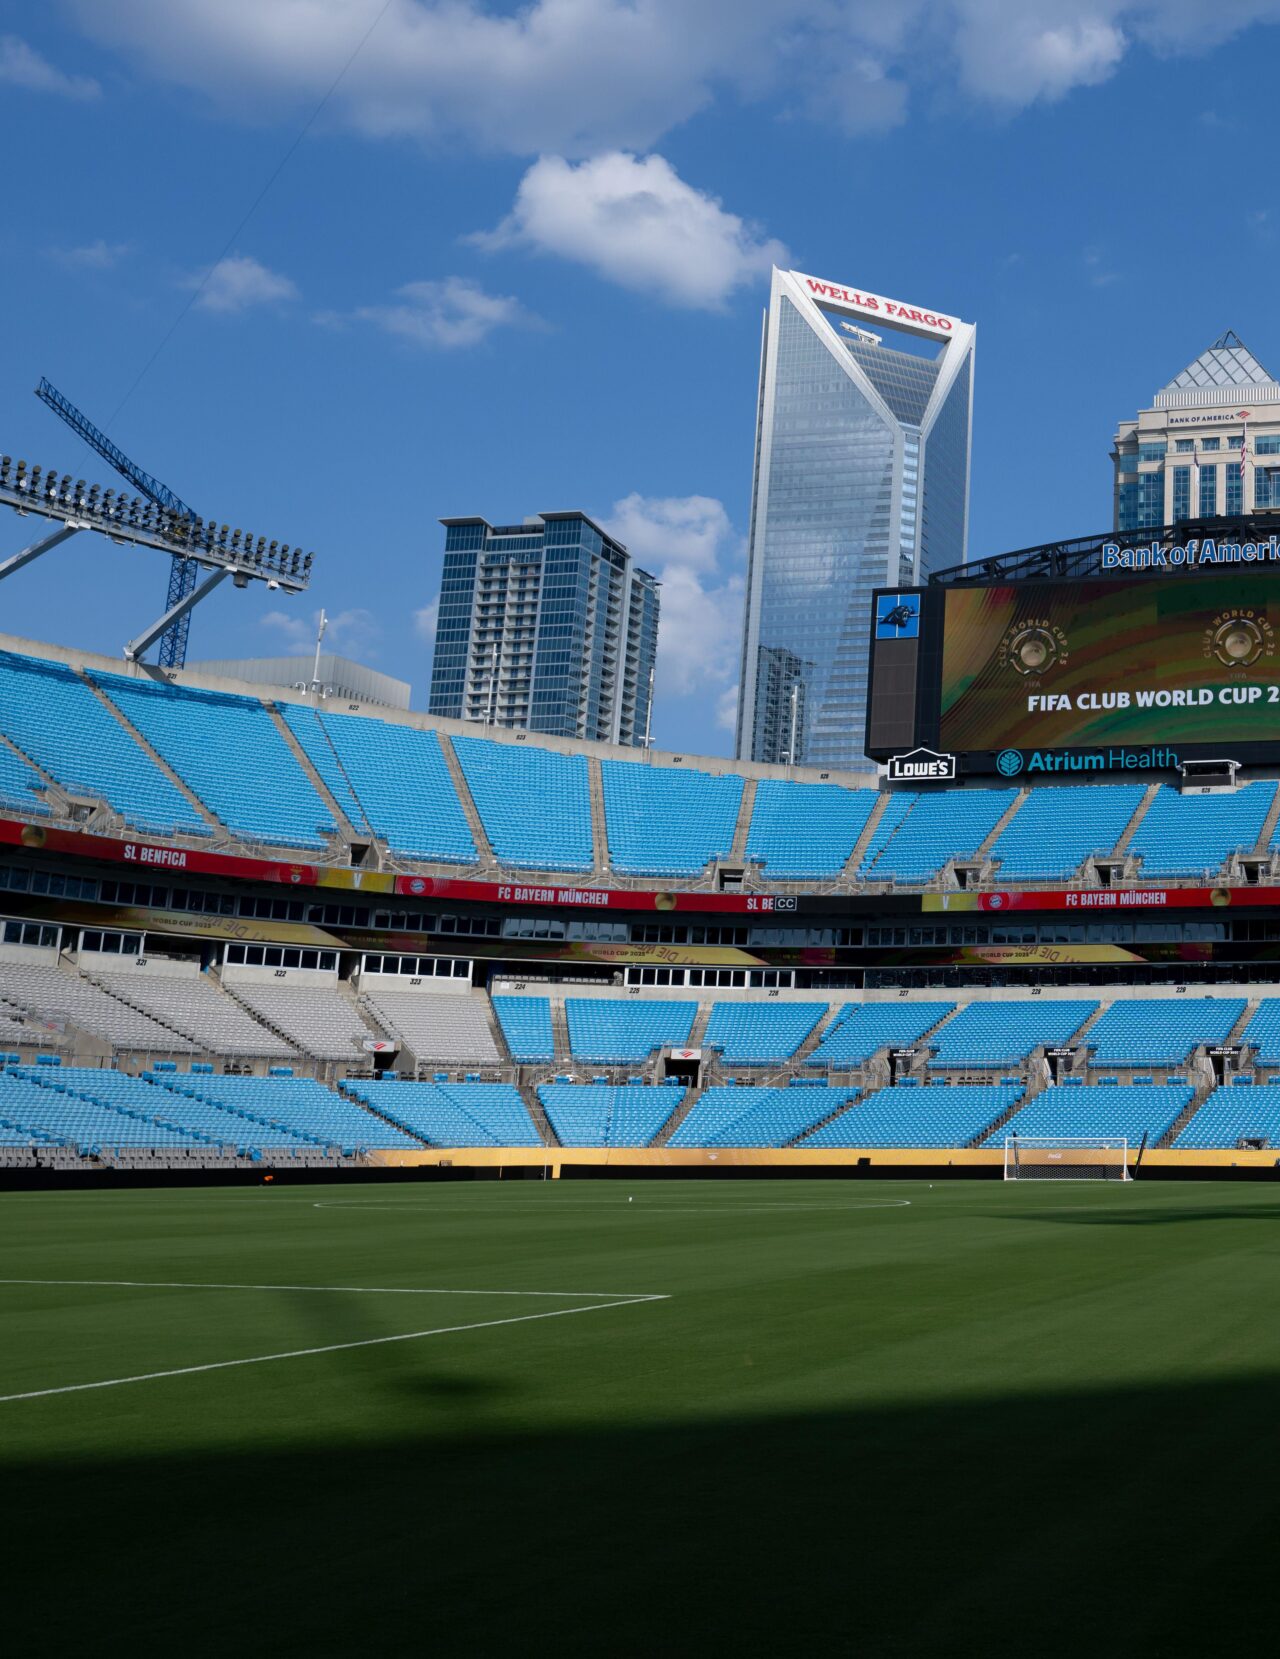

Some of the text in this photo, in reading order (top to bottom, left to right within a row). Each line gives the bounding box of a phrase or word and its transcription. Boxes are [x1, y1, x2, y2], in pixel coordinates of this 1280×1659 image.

[806, 279, 953, 331] WELLS FARGO
[1202, 414, 1235, 422] AMERICA
[1102, 541, 1168, 568] Bank
[1170, 538, 1198, 565] of
[1009, 618, 1050, 635] WORLD
[1051, 625, 1069, 648] CUP
[1212, 609, 1255, 627] WORLD
[1257, 615, 1274, 639] CUP
[1027, 694, 1073, 712] FIFA
[1076, 691, 1131, 710] CLUB
[1135, 688, 1214, 708] WORLD
[1218, 686, 1263, 704] CUP
[894, 758, 949, 777] LOWE'S
[1027, 747, 1178, 771] Atrium Health
[123, 844, 187, 867] SL BENFICA
[353, 872, 363, 888] V
[498, 886, 609, 905] FC BAYERN MÜNCHEN
[747, 897, 759, 910] SL
[777, 898, 794, 908] CC
[942, 895, 950, 910] V
[1066, 890, 1166, 906] FC BAYERN MÜNCHEN
[152, 917, 178, 926] WORLD
[179, 919, 193, 927] CUP
